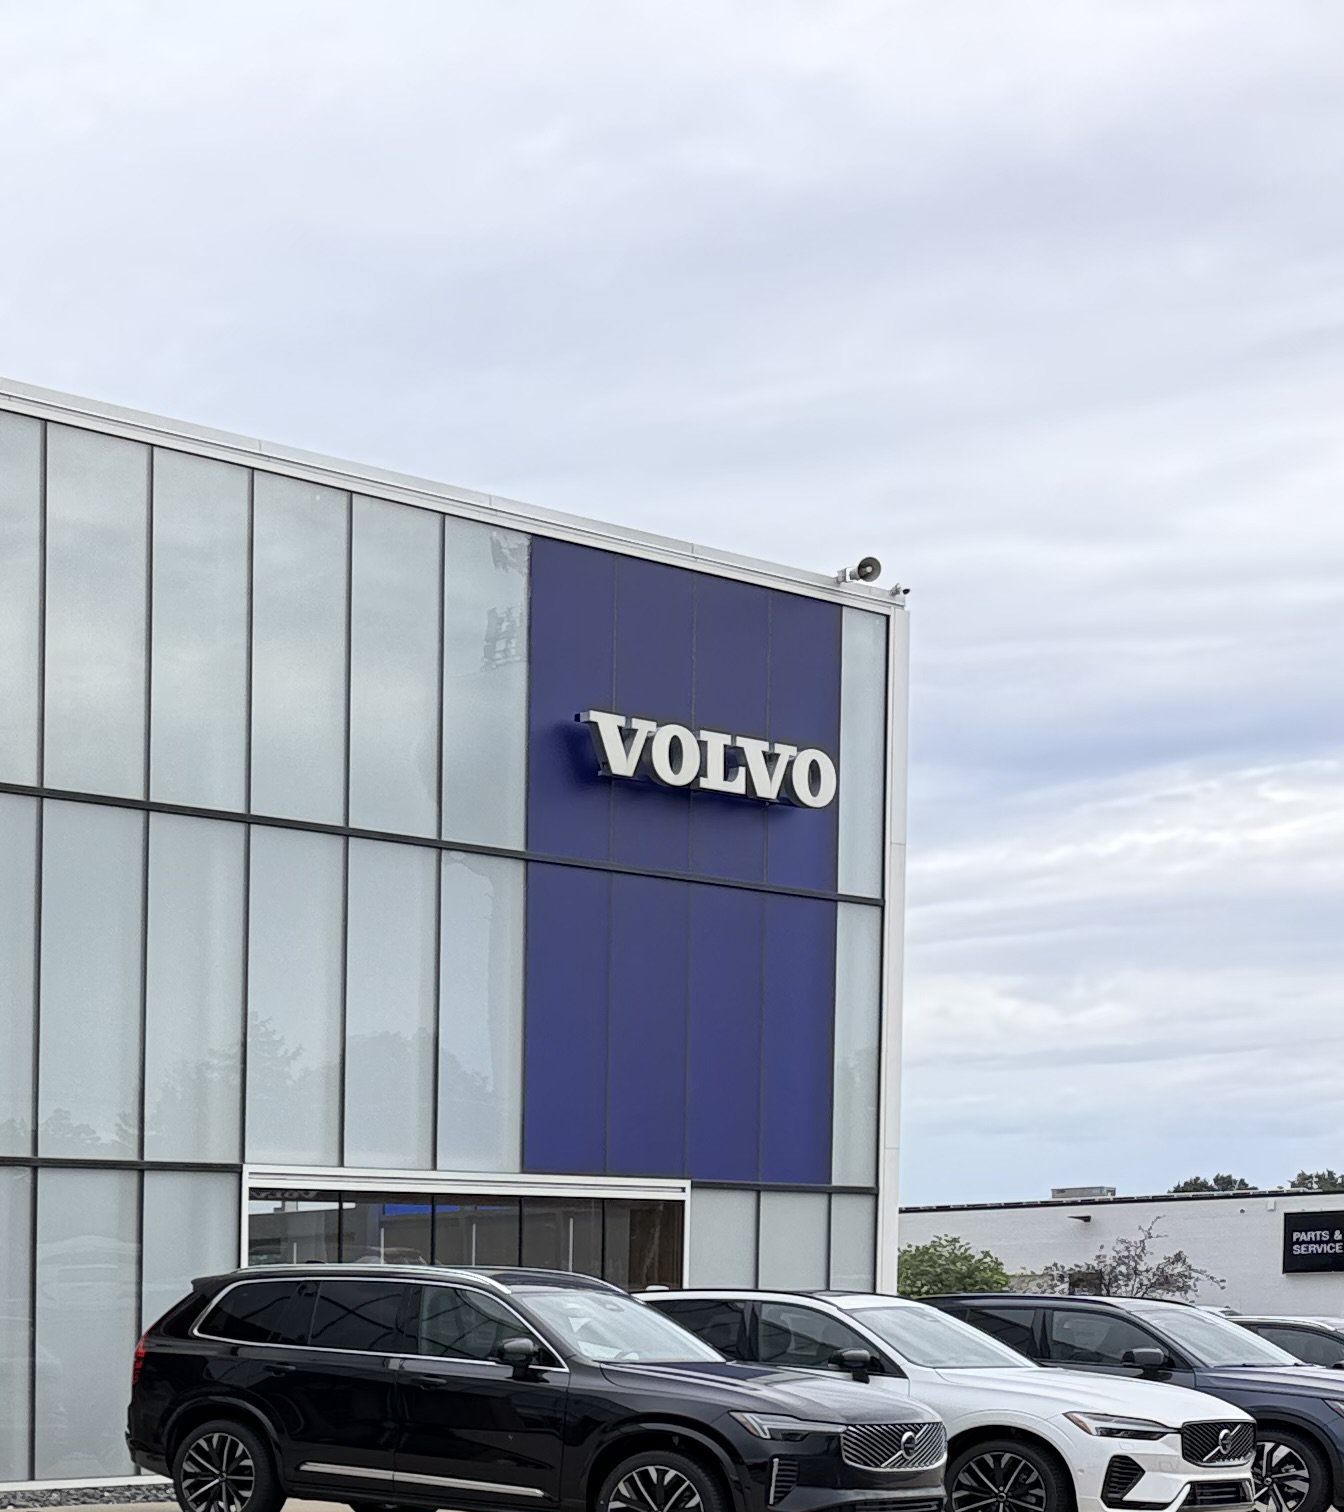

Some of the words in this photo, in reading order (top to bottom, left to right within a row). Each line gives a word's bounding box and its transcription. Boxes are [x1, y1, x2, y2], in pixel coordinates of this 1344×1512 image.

[580, 709, 837, 808] VOLVO
[1292, 1230, 1330, 1242] PARTS
[1333, 1229, 1343, 1241] &
[1292, 1242, 1344, 1255] SERVICE
